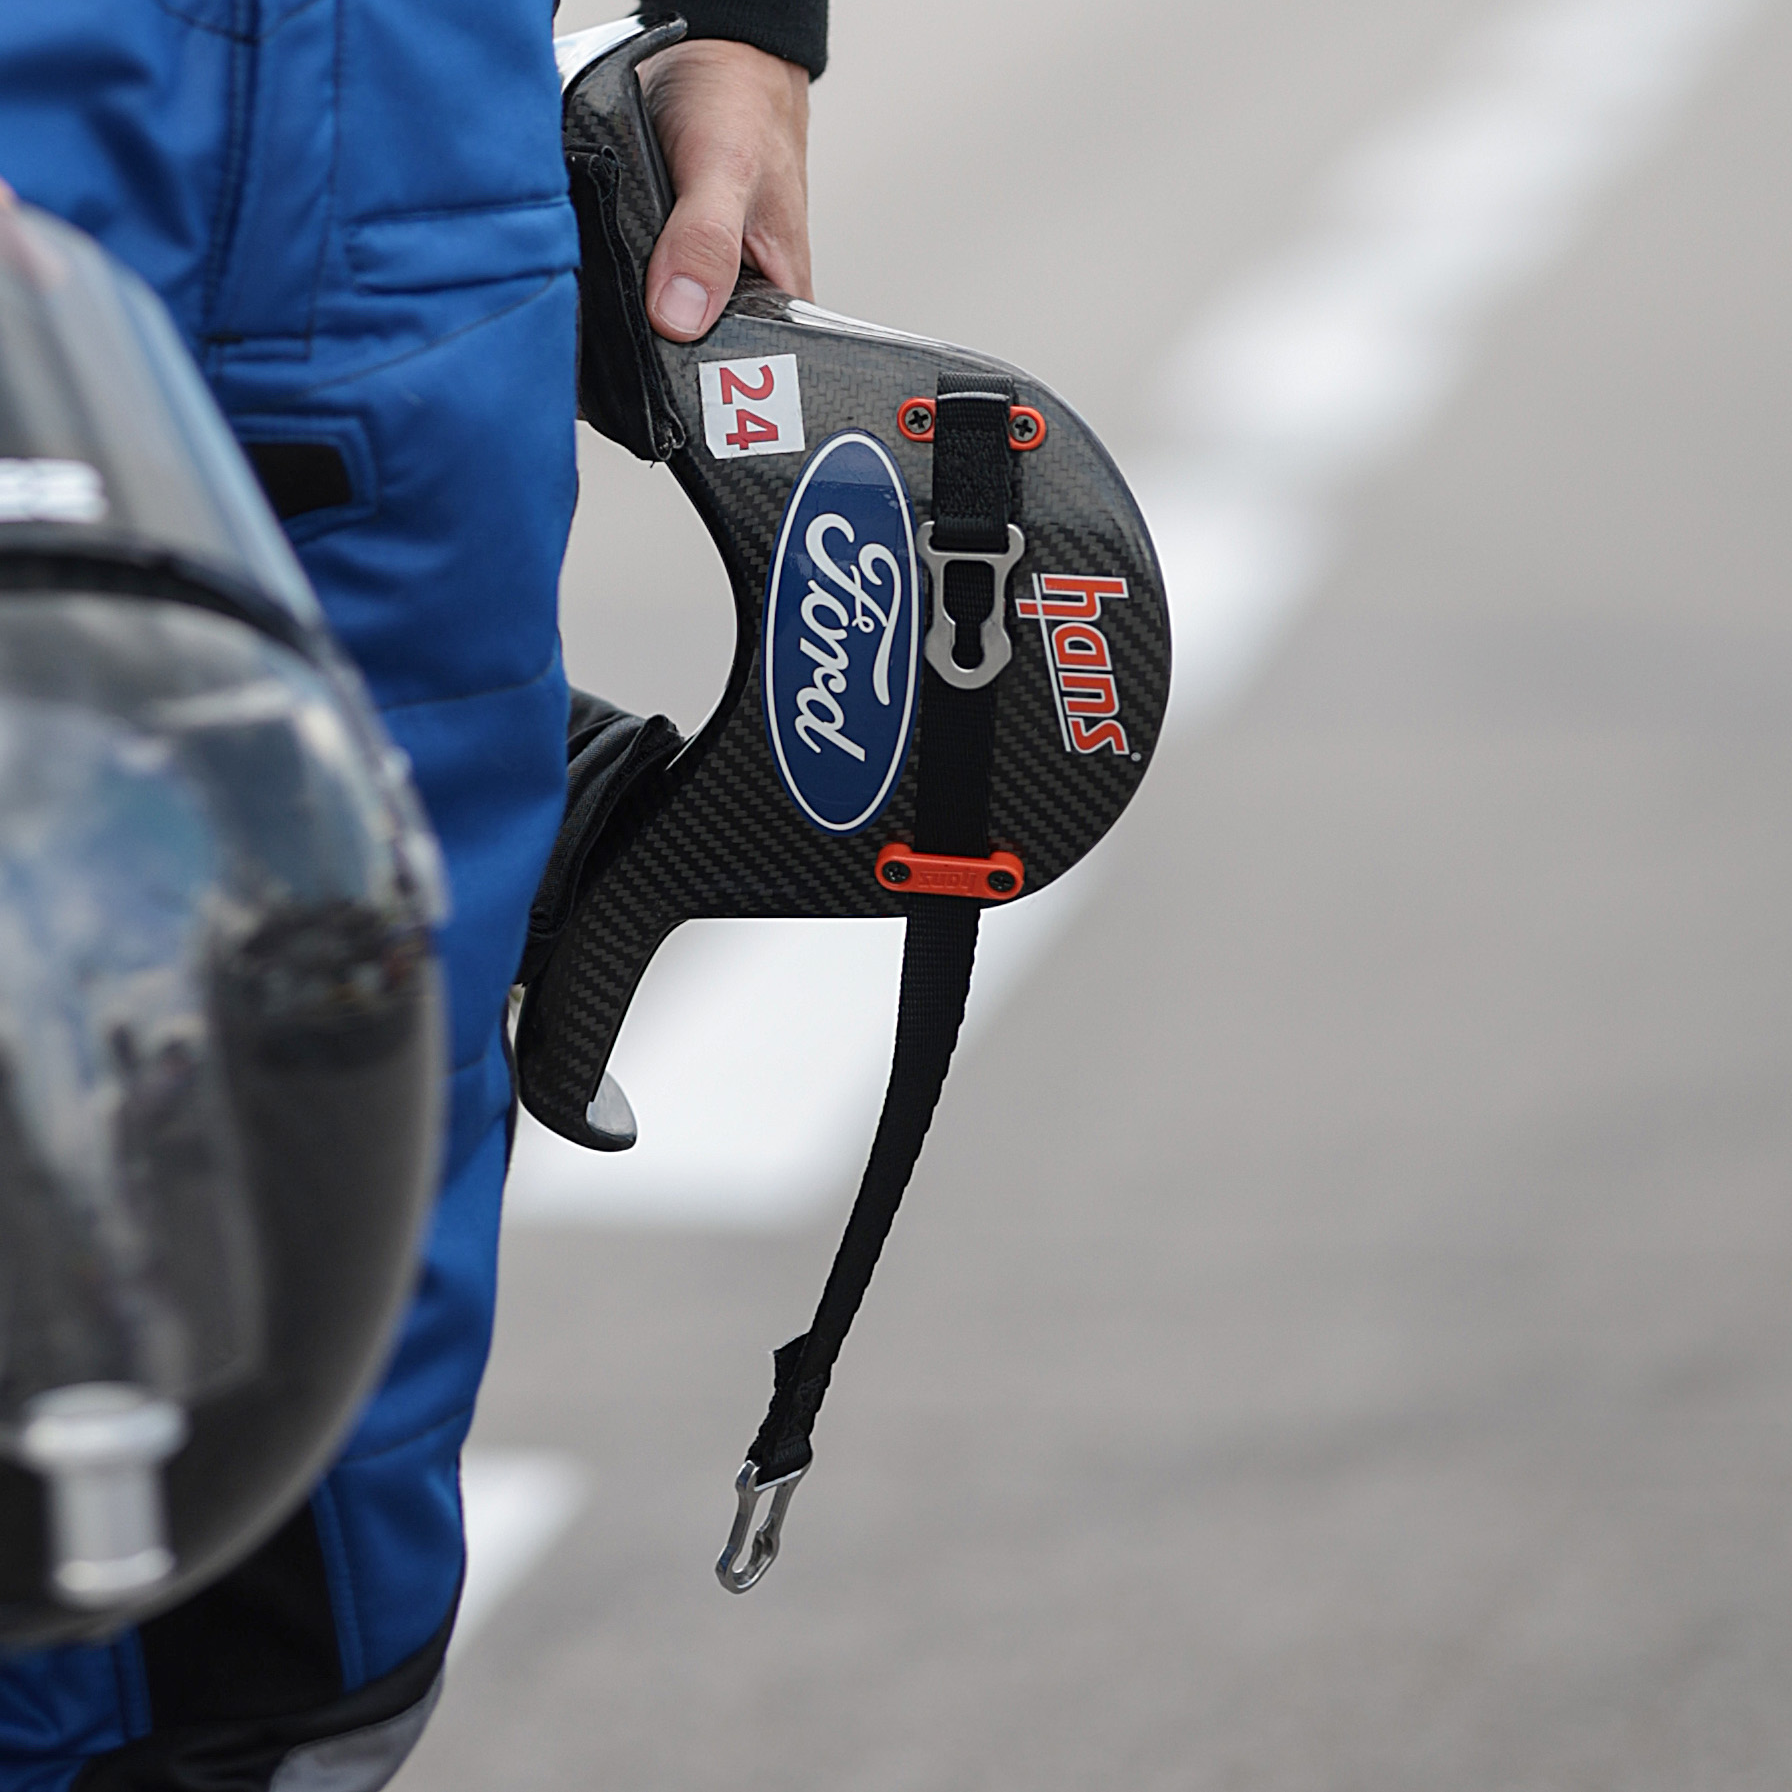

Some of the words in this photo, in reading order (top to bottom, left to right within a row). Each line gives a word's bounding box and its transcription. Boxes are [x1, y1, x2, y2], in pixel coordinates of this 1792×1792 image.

[719, 364, 780, 452] 24
[795, 513, 902, 762] Ford
[1015, 572, 1129, 755] hans
